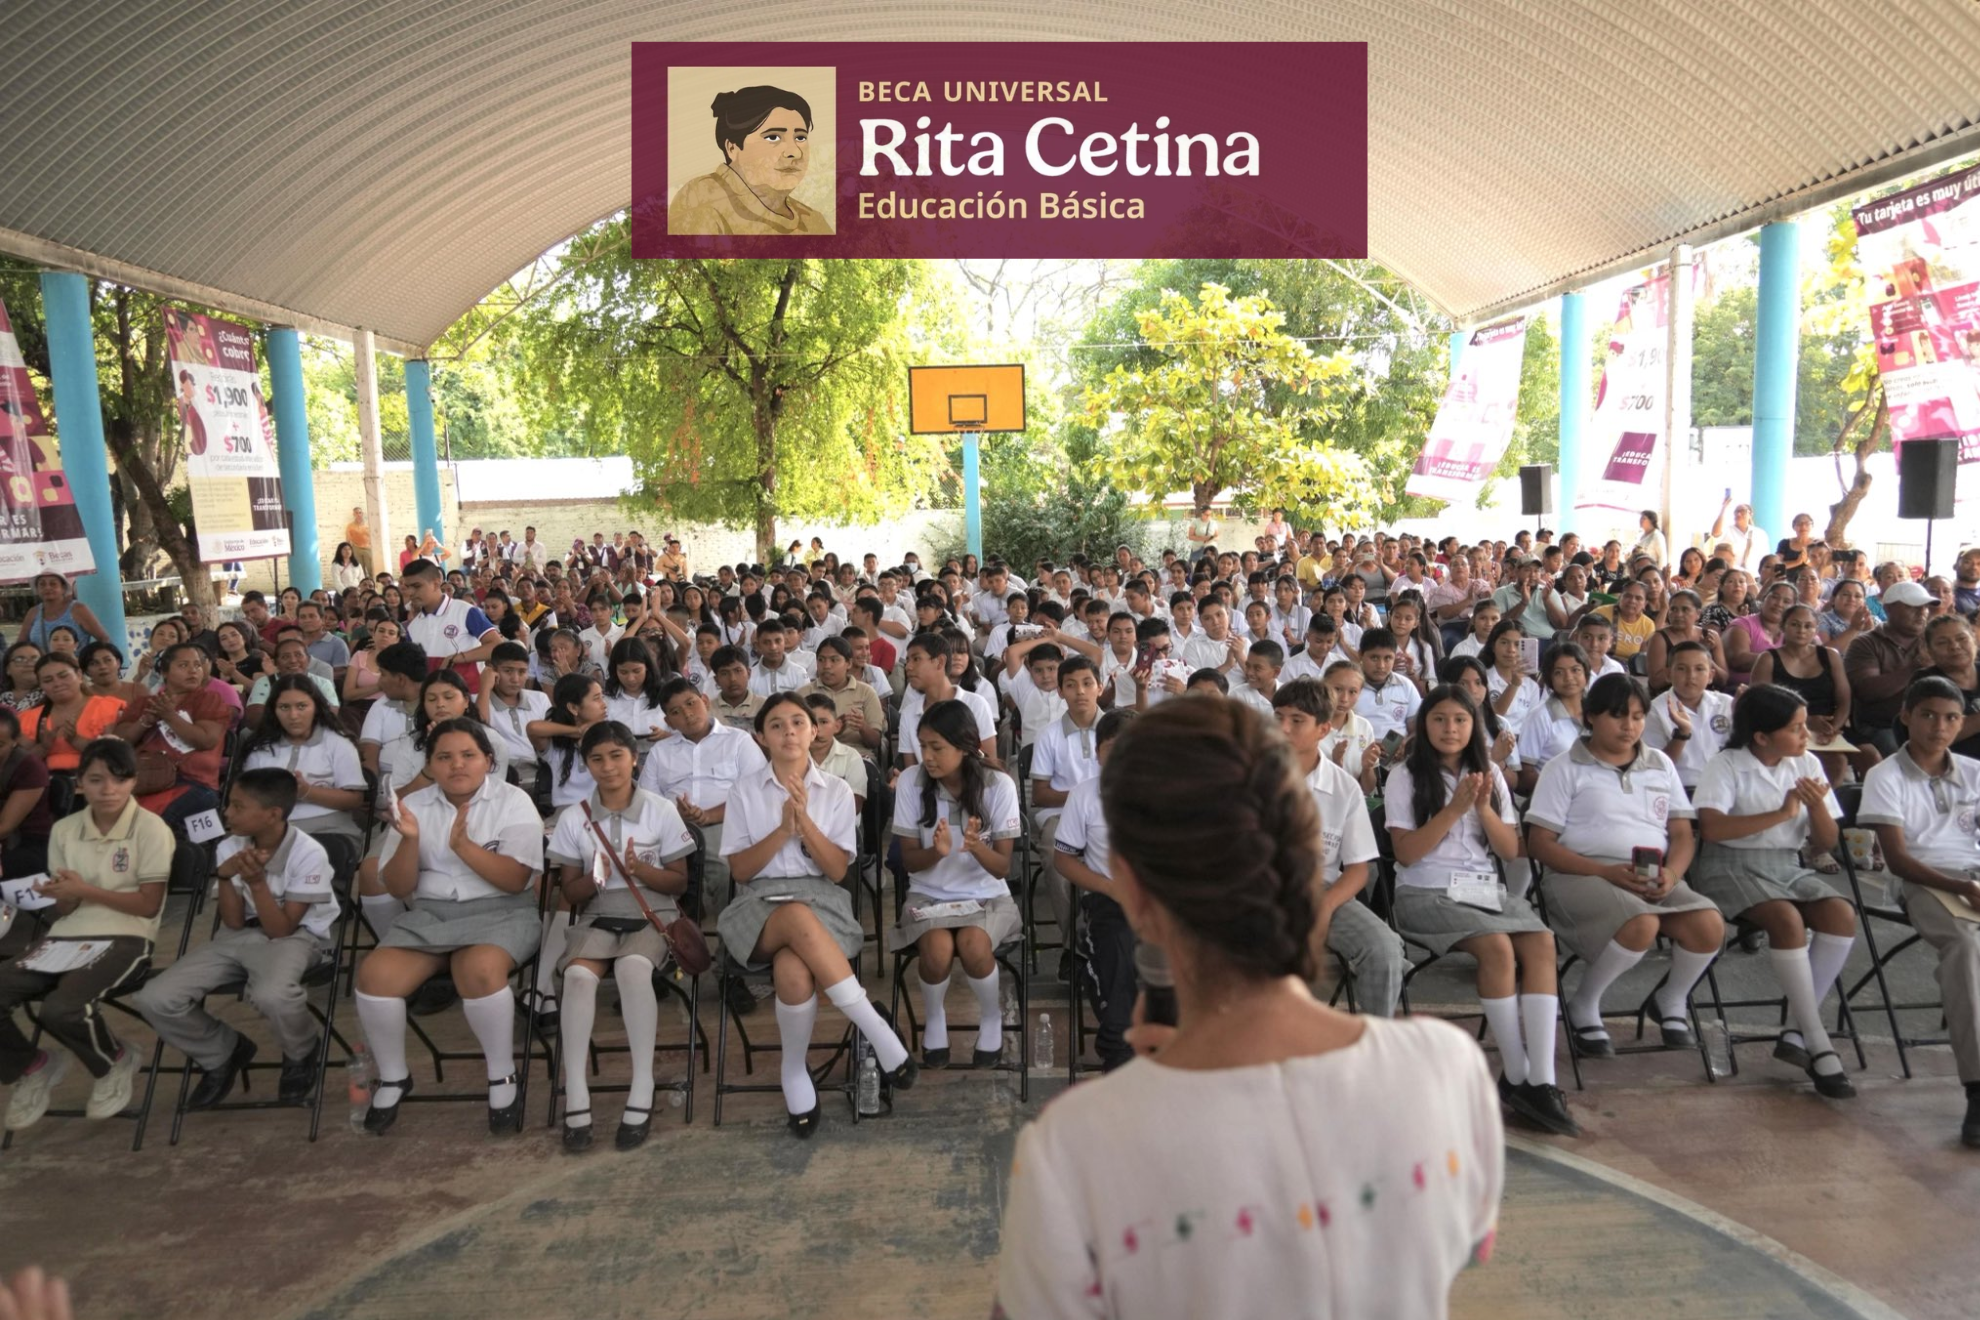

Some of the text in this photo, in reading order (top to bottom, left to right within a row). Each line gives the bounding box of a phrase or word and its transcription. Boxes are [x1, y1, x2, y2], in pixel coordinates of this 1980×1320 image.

[1858, 211, 1873, 225] Tu
[1875, 198, 1914, 220] tarjeta
[1916, 192, 1931, 207] es
[1932, 182, 1962, 200] muy
[205, 383, 248, 408] $1,900
[223, 436, 252, 453] $700
[12, 514, 27, 525] ES
[191, 815, 213, 833] F16
